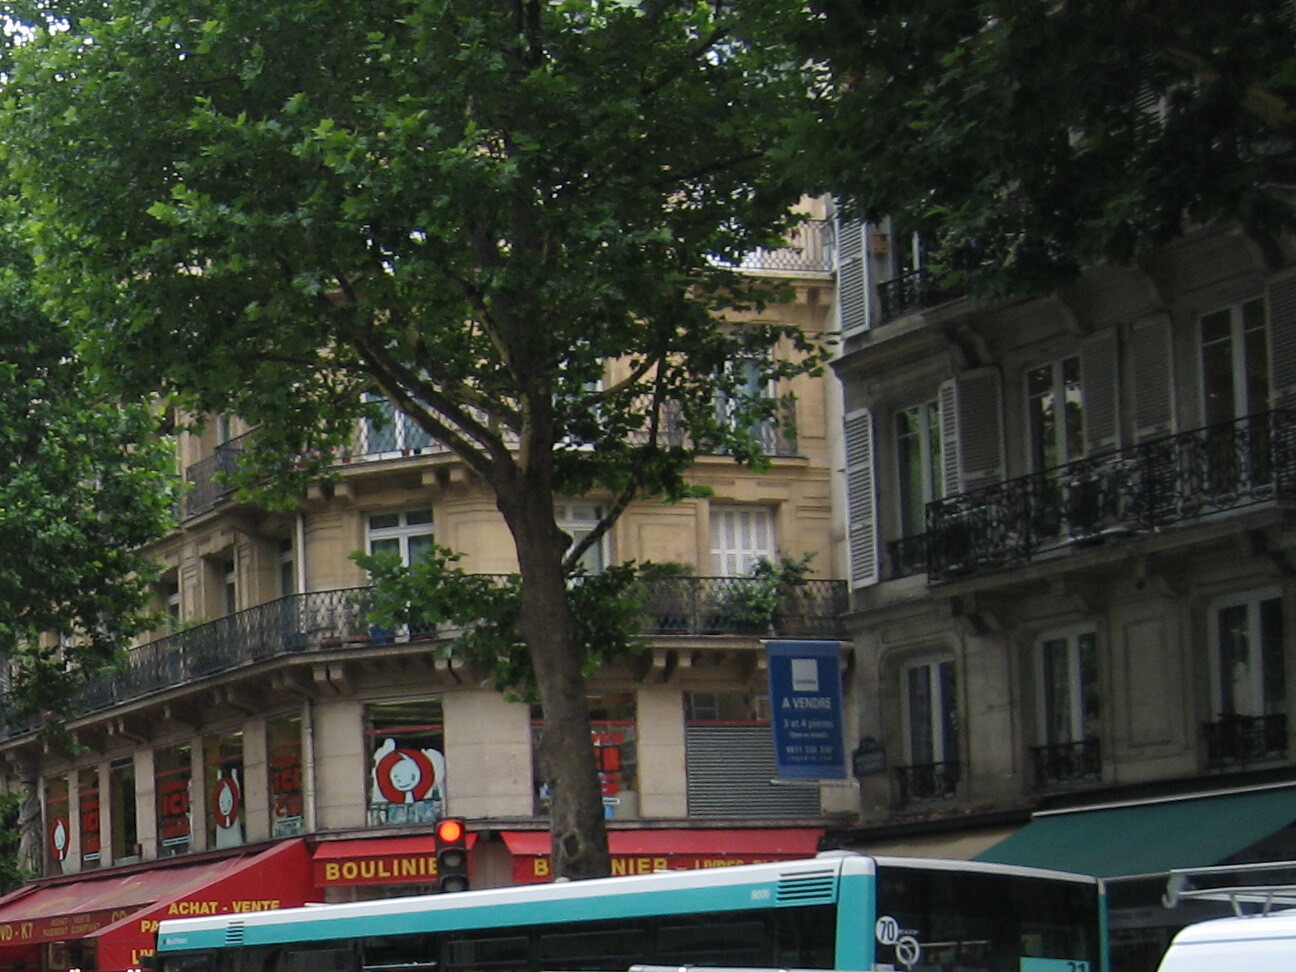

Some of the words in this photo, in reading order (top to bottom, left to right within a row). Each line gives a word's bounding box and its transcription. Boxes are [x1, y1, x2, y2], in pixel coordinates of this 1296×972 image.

[792, 697, 831, 709] VENDRE
[325, 857, 438, 880] BOULINIE
[168, 901, 218, 915] ACHAT
[232, 900, 280, 914] VENTE
[21, 922, 35, 939] K7
[879, 918, 895, 941] 70
